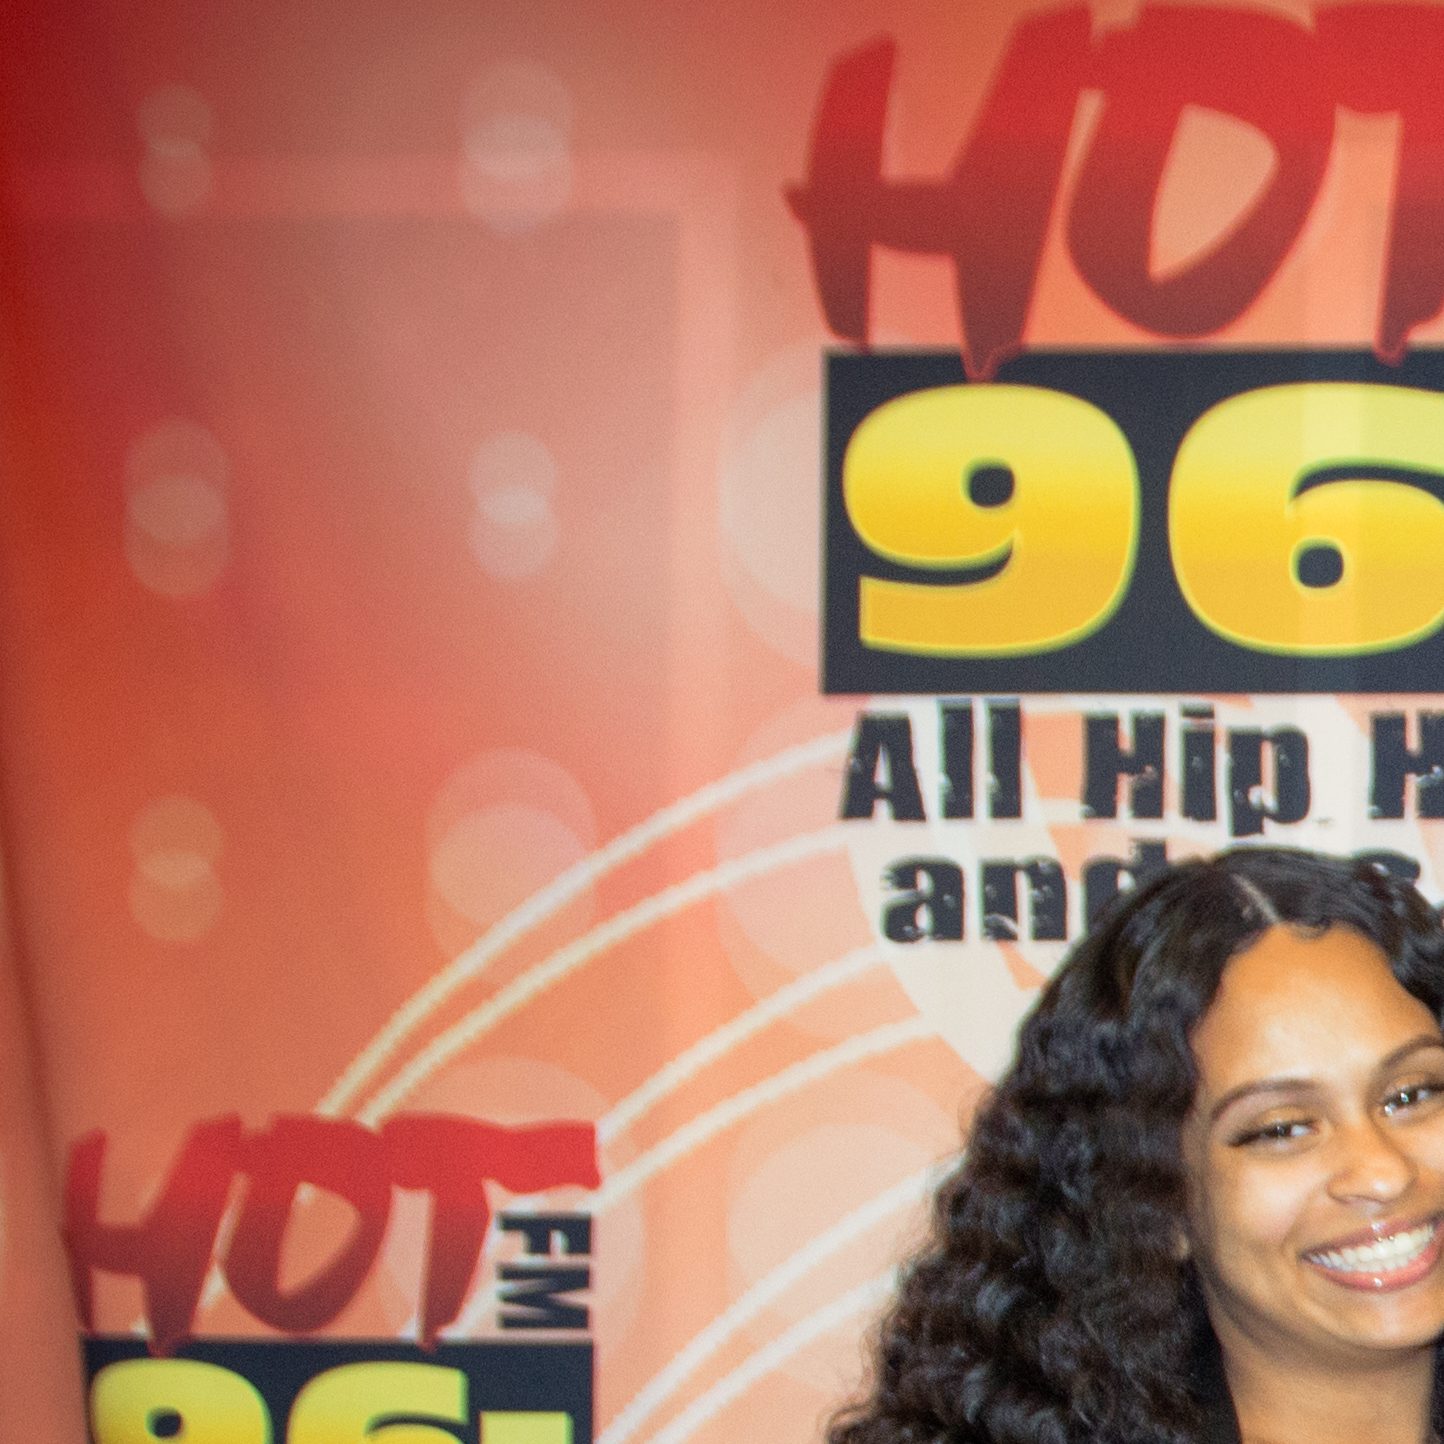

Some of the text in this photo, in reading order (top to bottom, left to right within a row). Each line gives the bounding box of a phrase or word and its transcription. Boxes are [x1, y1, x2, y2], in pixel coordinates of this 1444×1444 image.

[840, 698, 1023, 821] All
[1083, 703, 1312, 837] Hip
[57, 1112, 602, 1358] HOT
[496, 1211, 593, 1330] FM
